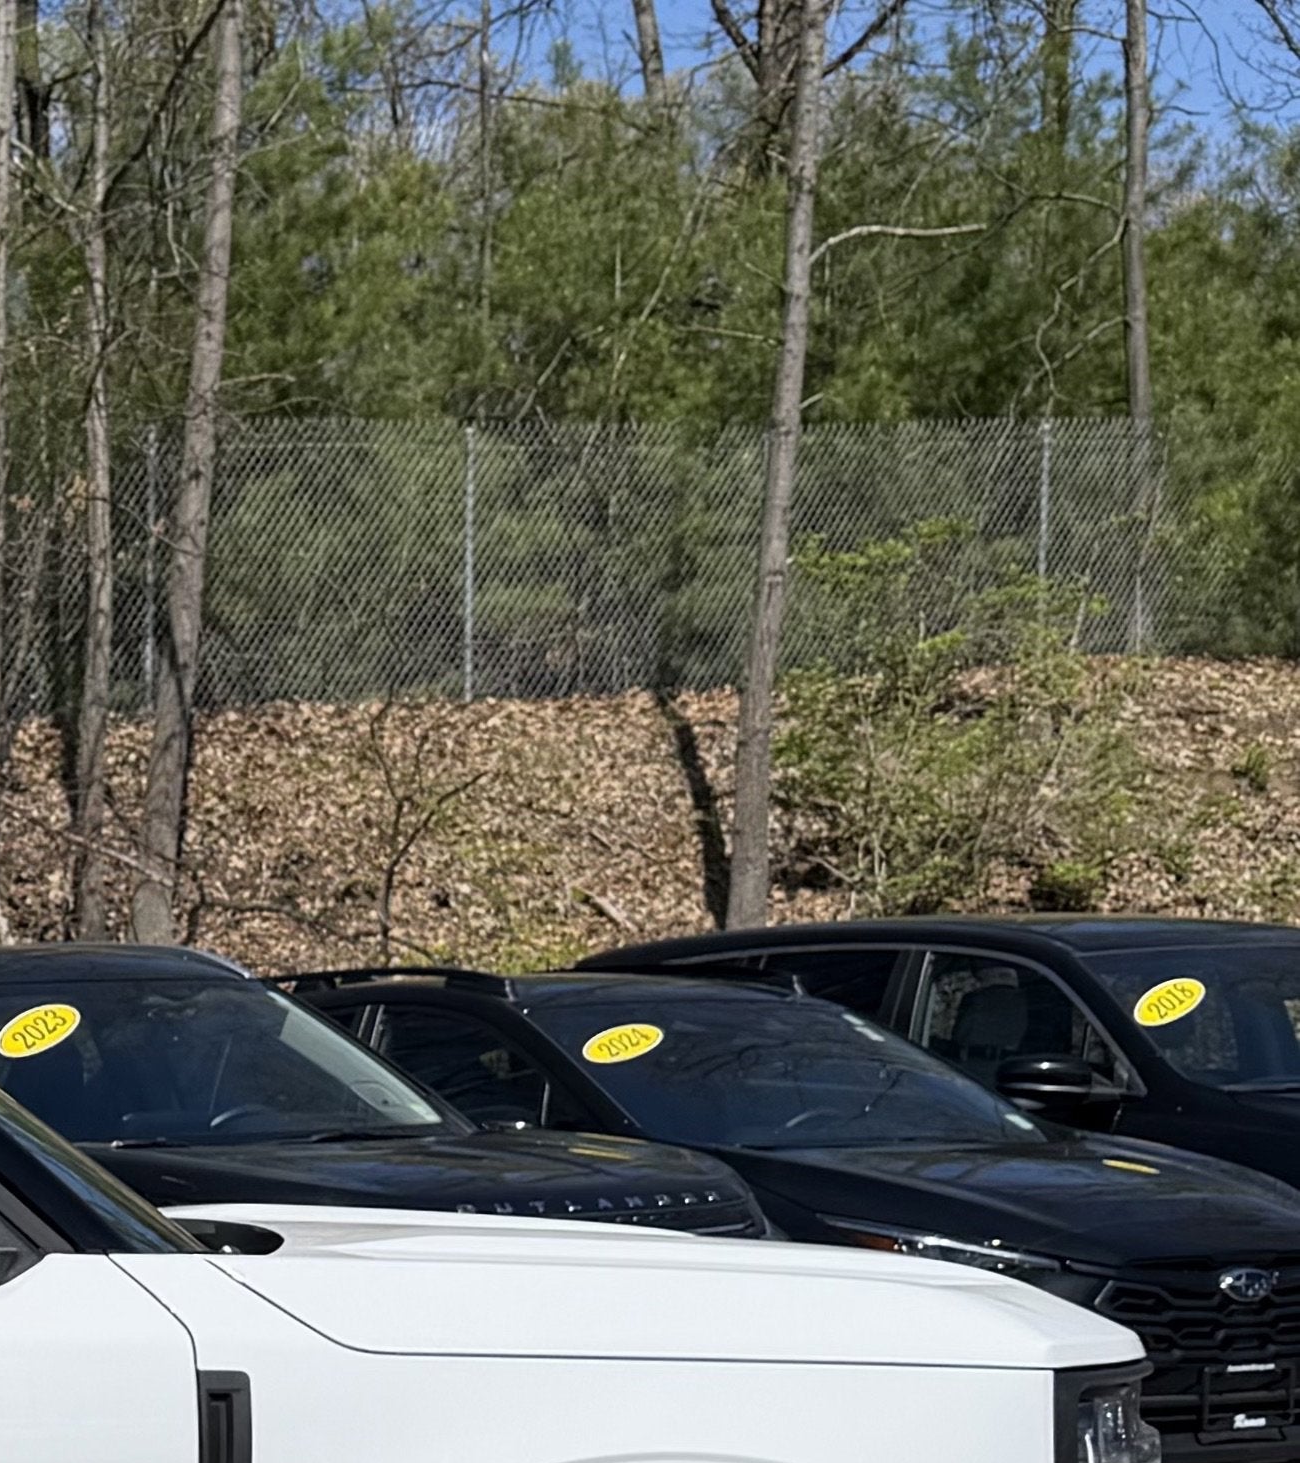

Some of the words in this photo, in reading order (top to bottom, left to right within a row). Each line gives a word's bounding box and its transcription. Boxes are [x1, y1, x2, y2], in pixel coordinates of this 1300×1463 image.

[1146, 983, 1195, 1019] 2018
[11, 1009, 68, 1050] 2023
[597, 1028, 651, 1058] 2024
[456, 1190, 720, 1214] OUTLANDER
